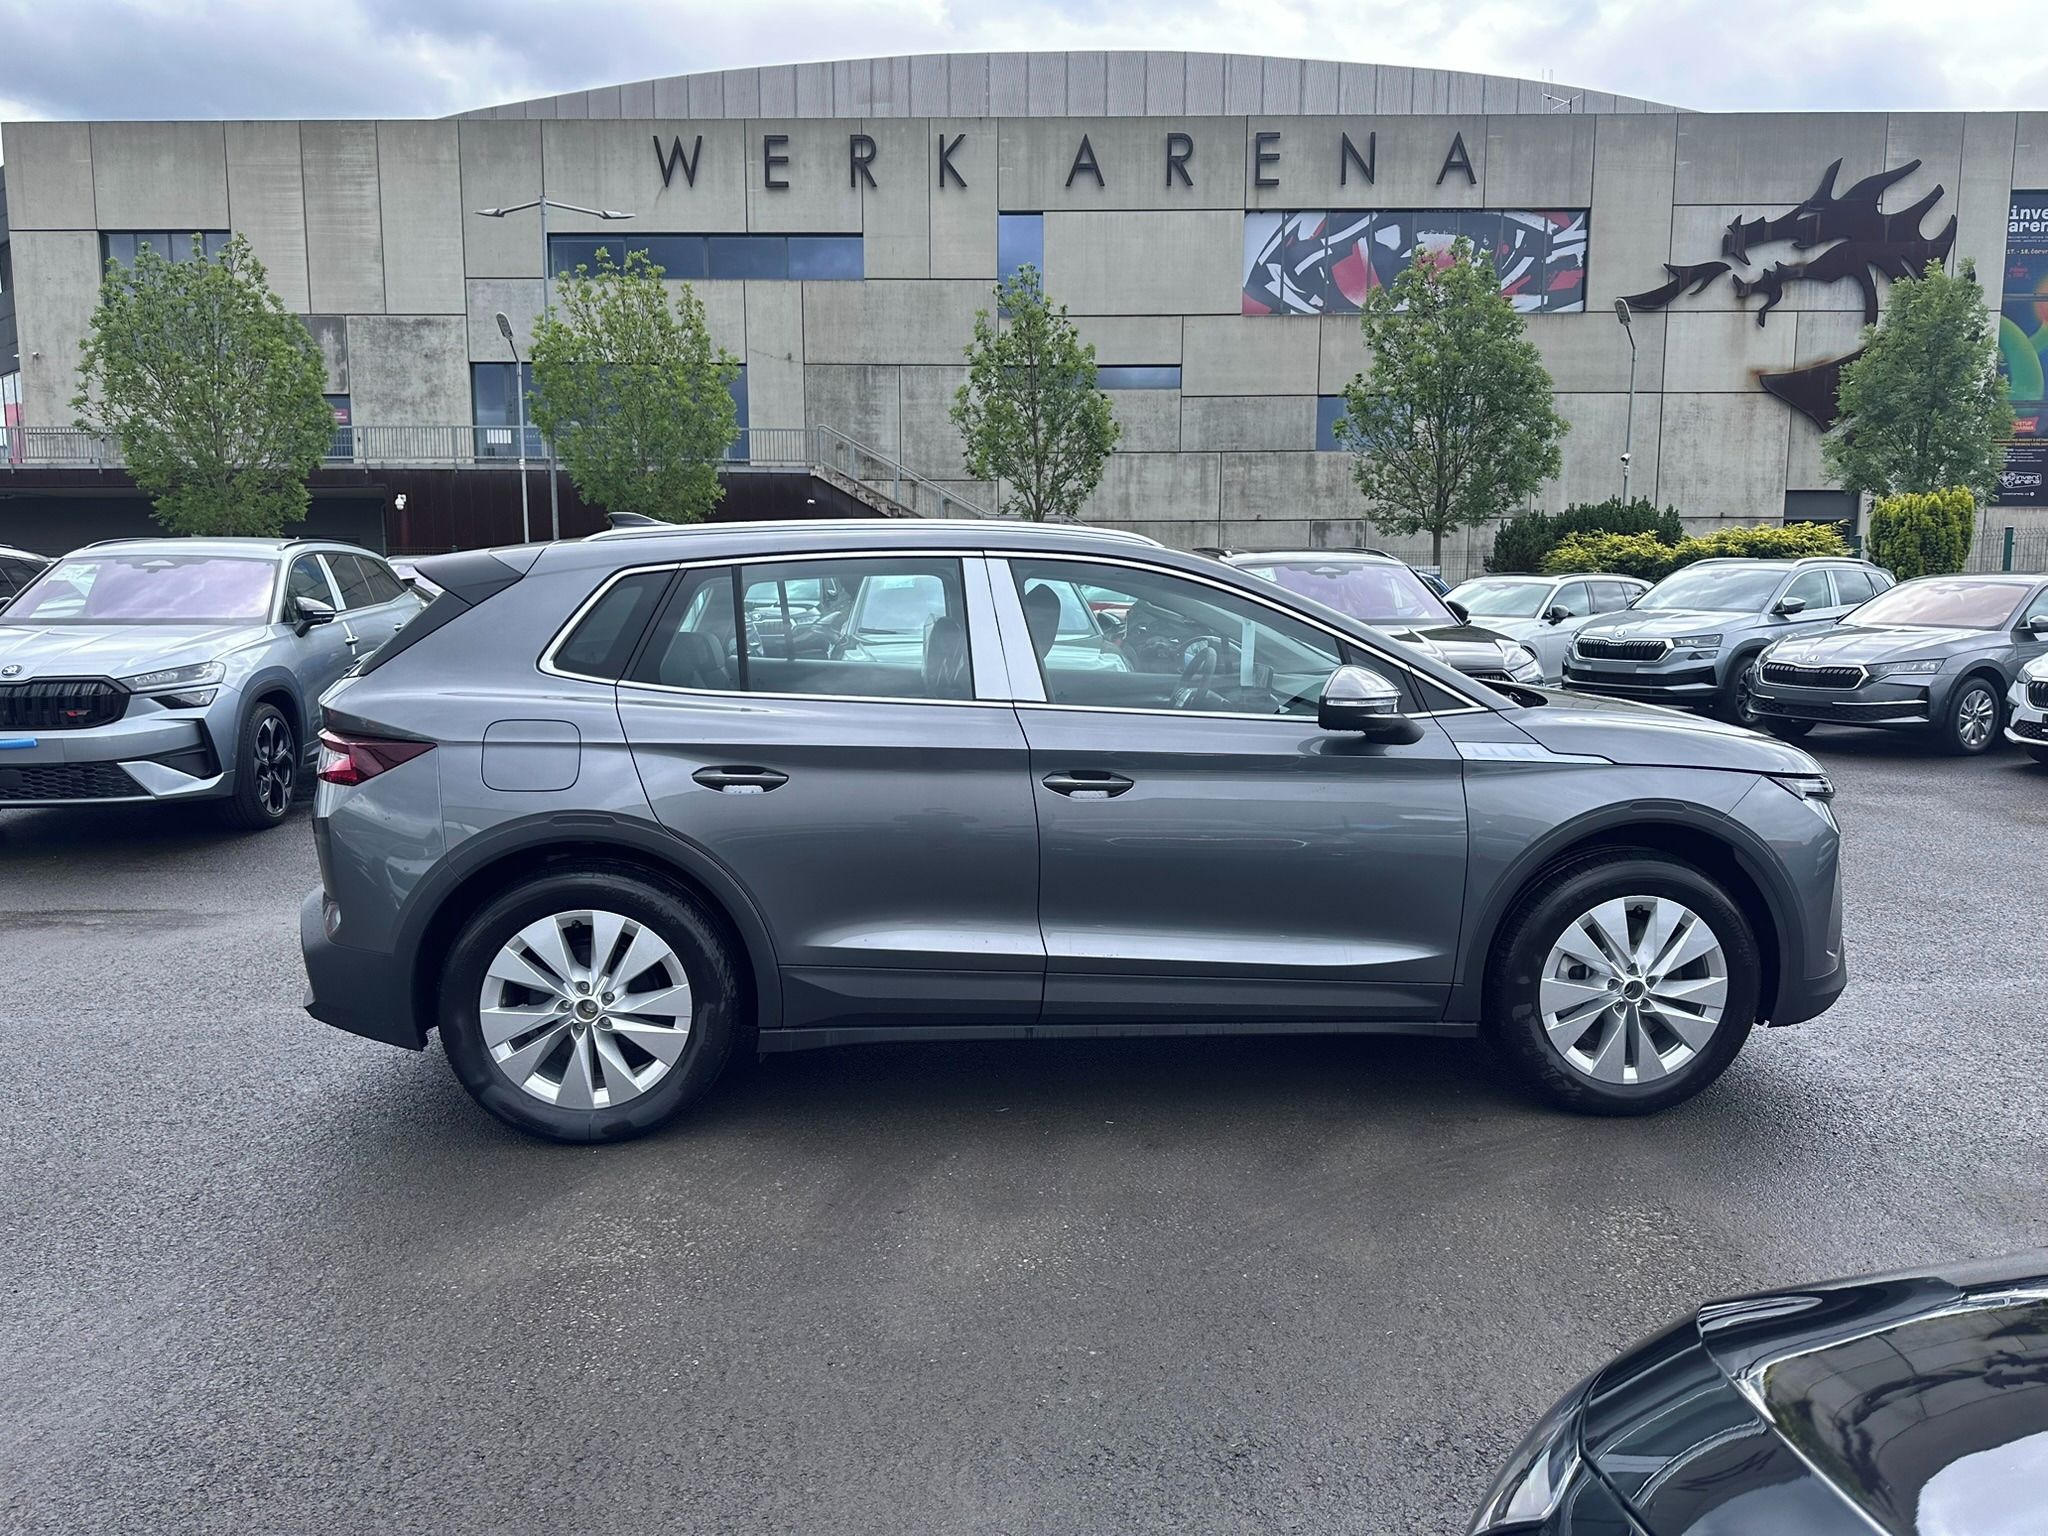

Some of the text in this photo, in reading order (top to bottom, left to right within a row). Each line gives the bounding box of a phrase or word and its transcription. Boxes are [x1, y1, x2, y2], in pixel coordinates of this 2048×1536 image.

[652, 131, 1477, 188] WERK ARENA
[2009, 205, 2048, 220] inve
